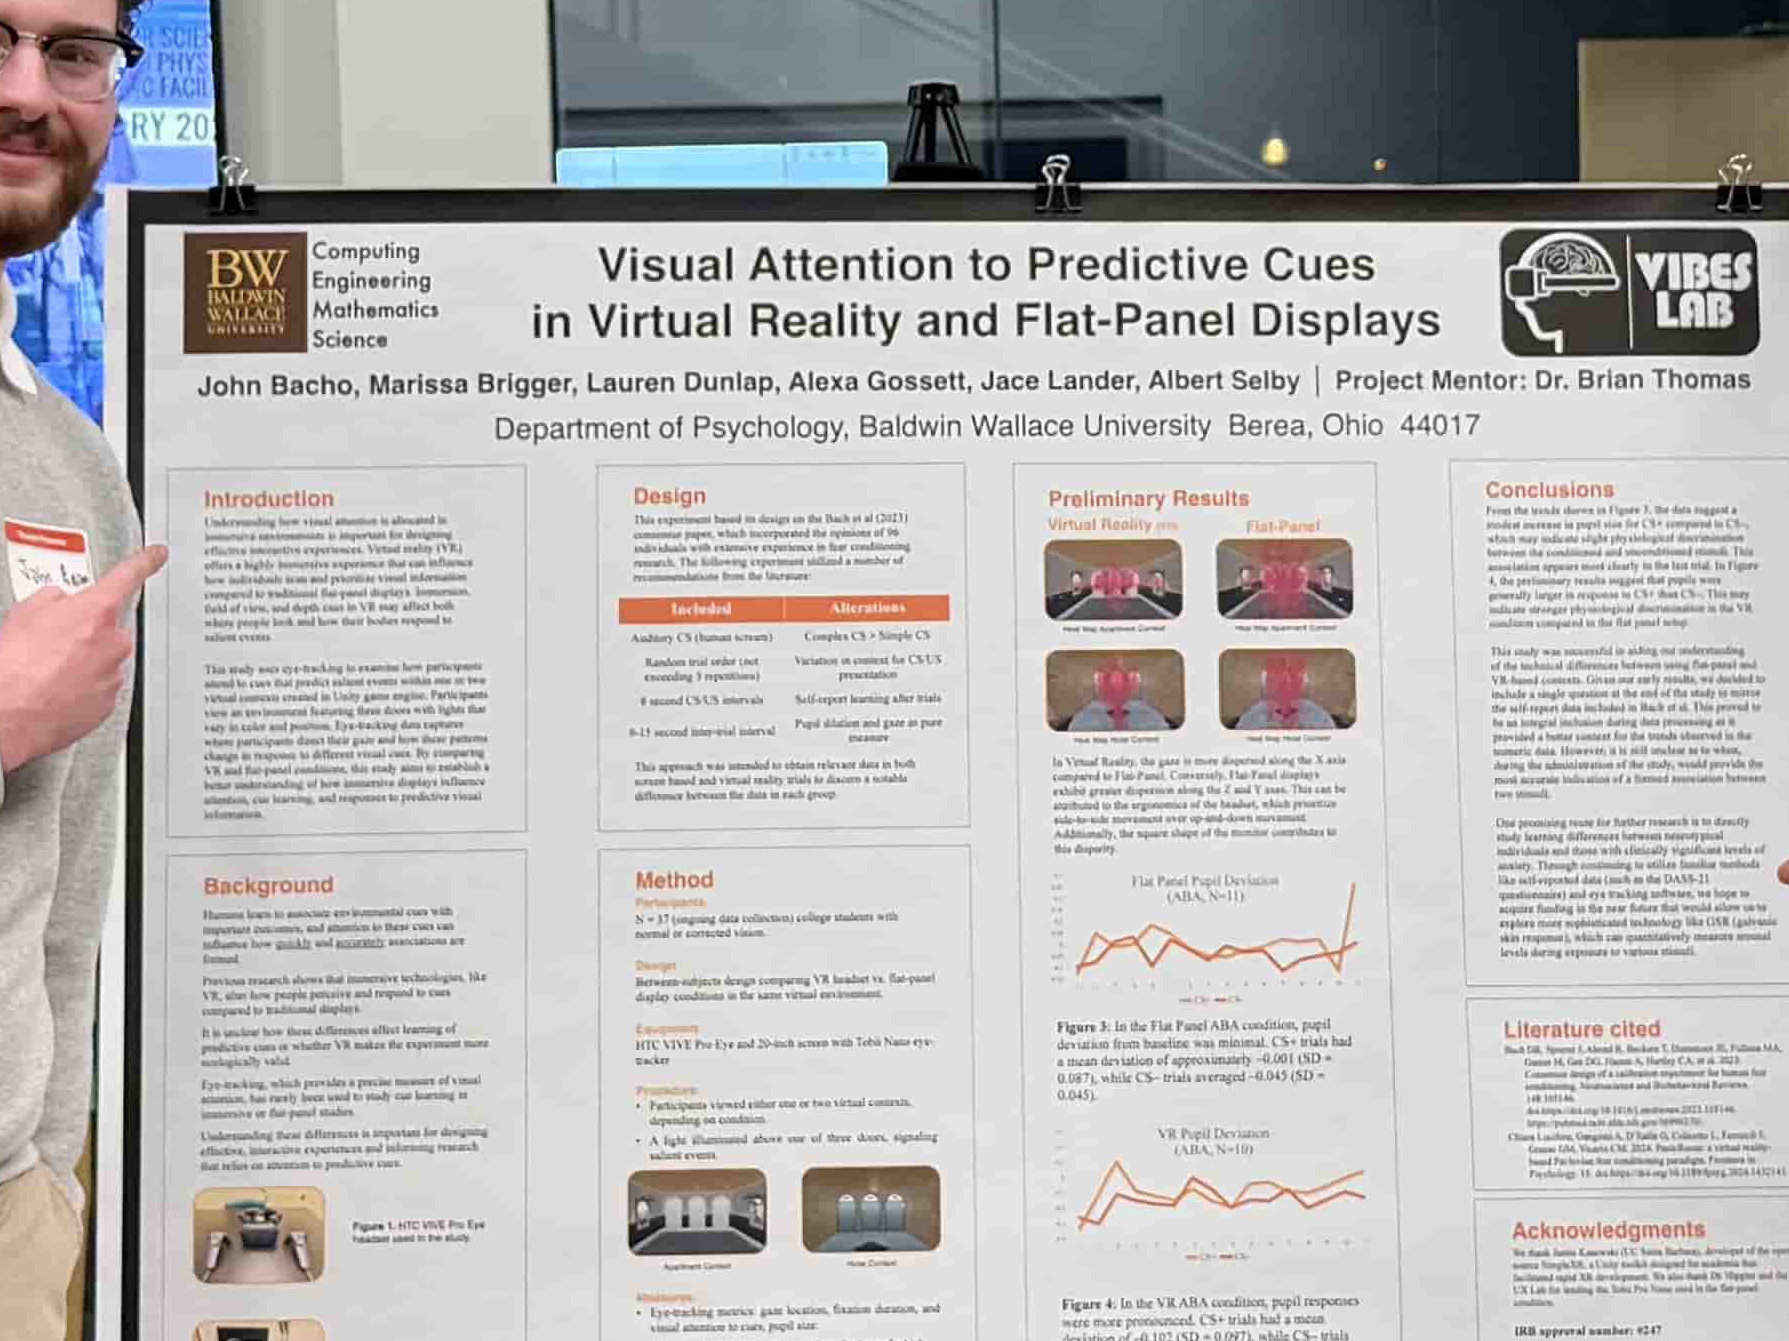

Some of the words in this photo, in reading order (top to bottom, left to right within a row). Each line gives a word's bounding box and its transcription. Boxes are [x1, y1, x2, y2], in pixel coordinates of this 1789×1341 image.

[311, 240, 420, 267] Computing
[597, 246, 734, 283] Visual
[748, 245, 954, 283] Attention
[967, 247, 1012, 282] to
[1028, 245, 1249, 282] Predictive
[1263, 246, 1376, 282] Cues
[205, 249, 290, 289] BW
[1634, 252, 1753, 292] VIBES
[311, 269, 432, 295] Engineering
[207, 289, 286, 306] BALDWIN
[312, 296, 440, 320] Mathematics
[207, 307, 286, 323] WALLACE
[1656, 291, 1735, 329] LAB
[207, 324, 285, 336] UNIVERSITY
[532, 303, 571, 339] in
[587, 302, 732, 339] Virtual
[750, 301, 903, 348] Reality
[916, 301, 998, 338] and
[1015, 301, 1235, 338] Flat-Panel
[1252, 301, 1441, 347] Displays
[312, 329, 388, 349] Science
[196, 374, 262, 398] John
[270, 372, 361, 401] Bacho,
[368, 372, 469, 396] Marissa
[477, 370, 578, 401] Brigger,
[586, 371, 676, 394] Lauren
[683, 369, 781, 399] Dunlap,
[788, 369, 859, 392] Alexa
[866, 369, 973, 395] Gossett,
[980, 369, 1040, 392] Jace
[1048, 369, 1141, 395] Lander,
[1148, 368, 1224, 392] Albert
[1231, 369, 1301, 397] Selby
[1335, 369, 1425, 396] Project
[1431, 369, 1527, 391] Mentor:
[1535, 368, 1570, 392] Dr.
[1578, 367, 1644, 390] Brian
[1650, 367, 1752, 391] Thomas
[494, 416, 652, 447] Department
[658, 414, 684, 443] of
[693, 413, 849, 446] Psychology,
[859, 412, 963, 439] Baldwin
[970, 412, 1075, 438] Wallace
[1084, 412, 1212, 443] University
[1228, 411, 1313, 442] Berea,
[1322, 412, 1384, 437] Ohio
[1399, 412, 1481, 437] 44017
[203, 489, 335, 510] Introduction
[633, 486, 707, 509] Design
[1048, 489, 1166, 513] Preliminary
[1171, 489, 1251, 507] Results
[1485, 480, 1616, 499] Conclusions
[671, 601, 733, 616] Included
[829, 601, 907, 615] Alterations
[202, 874, 335, 899] Background
[635, 870, 715, 891] Method
[1056, 1020, 1097, 1037] Figure
[1129, 1019, 1148, 1033] the
[1504, 1019, 1605, 1041] Literature
[1609, 1019, 1662, 1039] cited
[1511, 1220, 1707, 1244] Acknowledgments
[1539, 1324, 1587, 1339] approval
